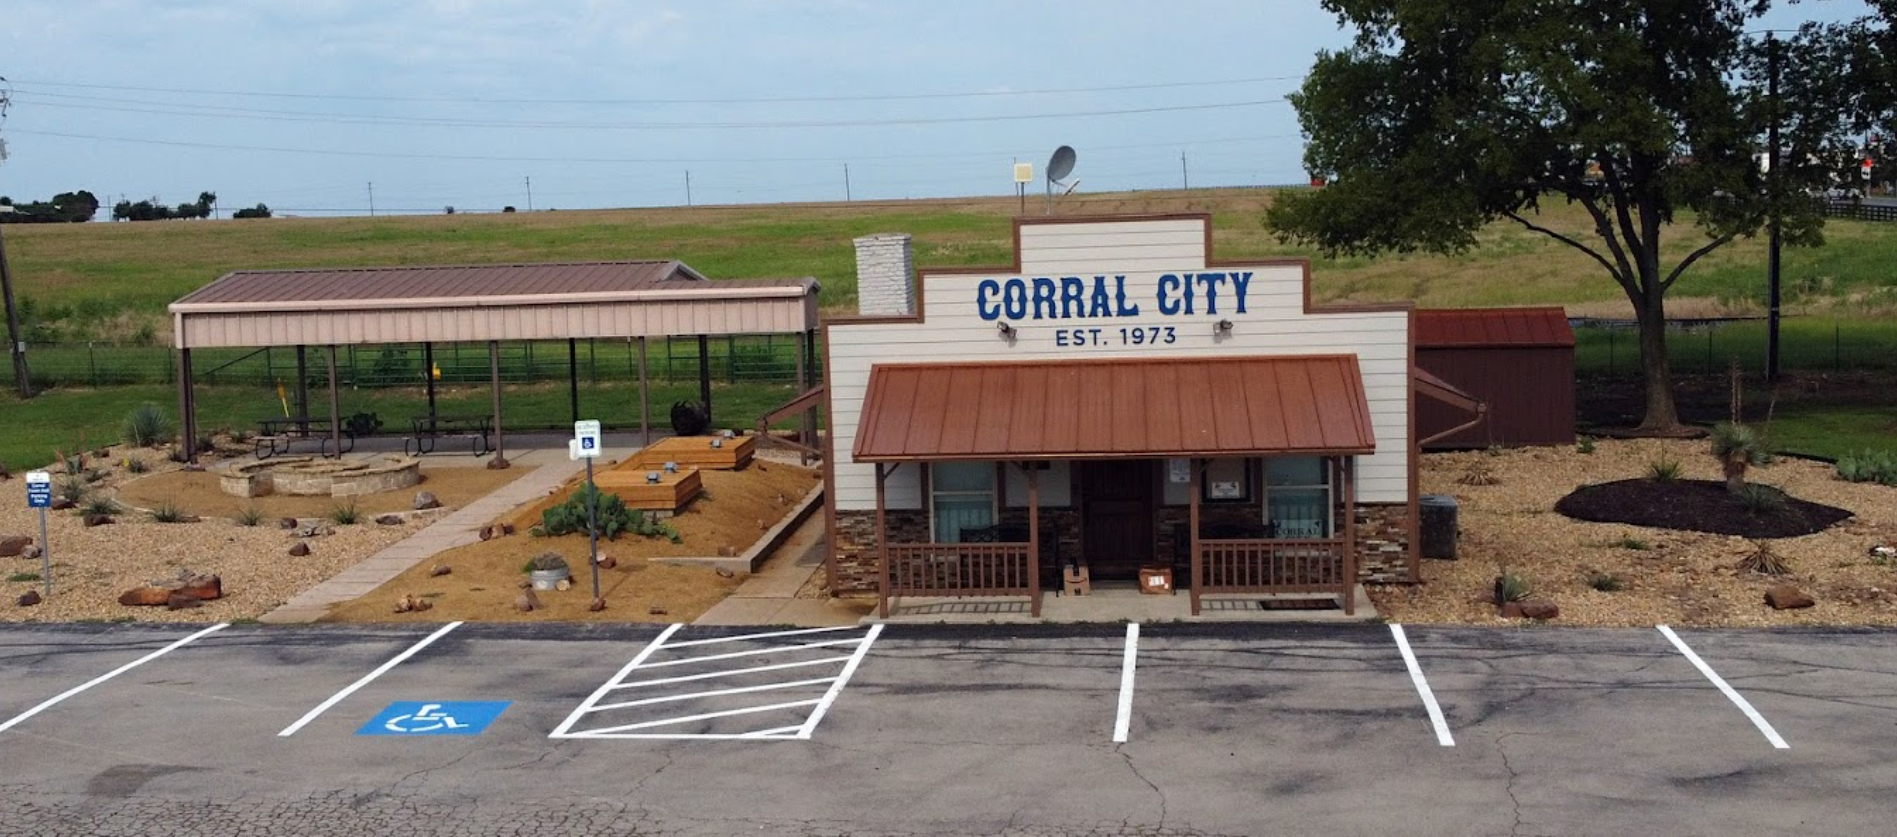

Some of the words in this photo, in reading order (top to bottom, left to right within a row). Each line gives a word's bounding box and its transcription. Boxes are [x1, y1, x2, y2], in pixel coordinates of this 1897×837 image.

[977, 275, 1139, 321] CORRAL
[1157, 272, 1253, 315] CITY
[1056, 330, 1108, 347] EST.
[1120, 327, 1176, 345] 1973
[1275, 528, 1320, 536] CORRAL
